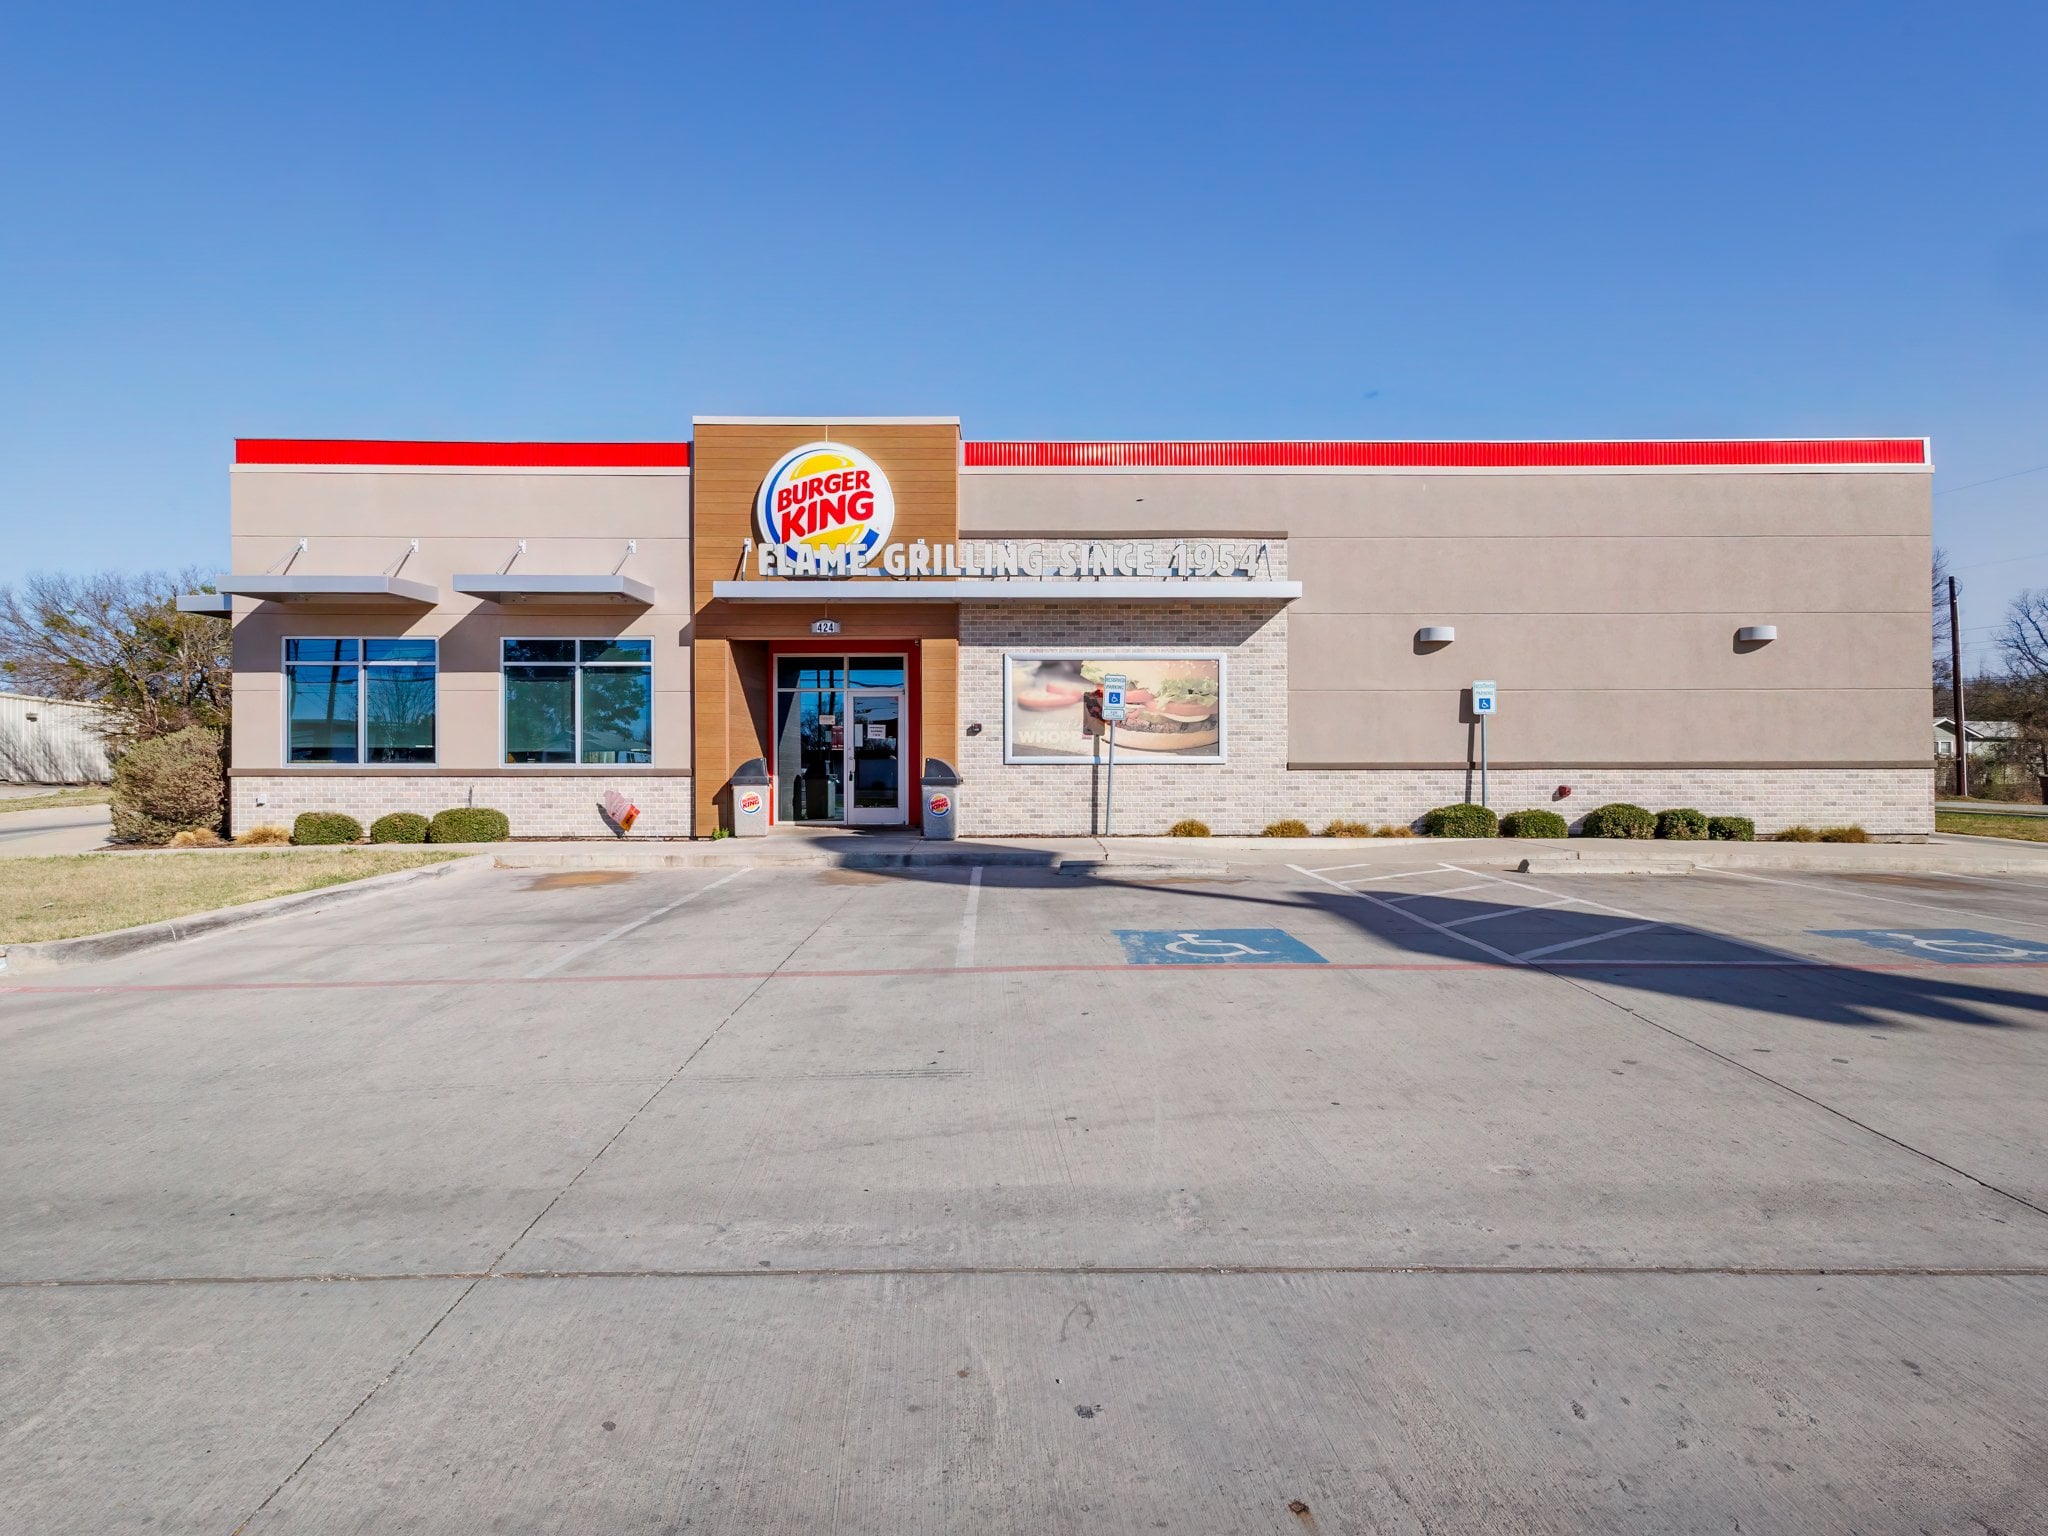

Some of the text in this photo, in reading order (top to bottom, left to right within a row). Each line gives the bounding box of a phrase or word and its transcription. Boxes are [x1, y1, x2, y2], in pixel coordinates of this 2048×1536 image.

[778, 470, 870, 512] BURGER
[781, 490, 874, 544] KING
[758, 543, 1258, 576] FLAME GRILLING SINCE 1954
[817, 622, 833, 632] 424
[742, 800, 760, 808] KING
